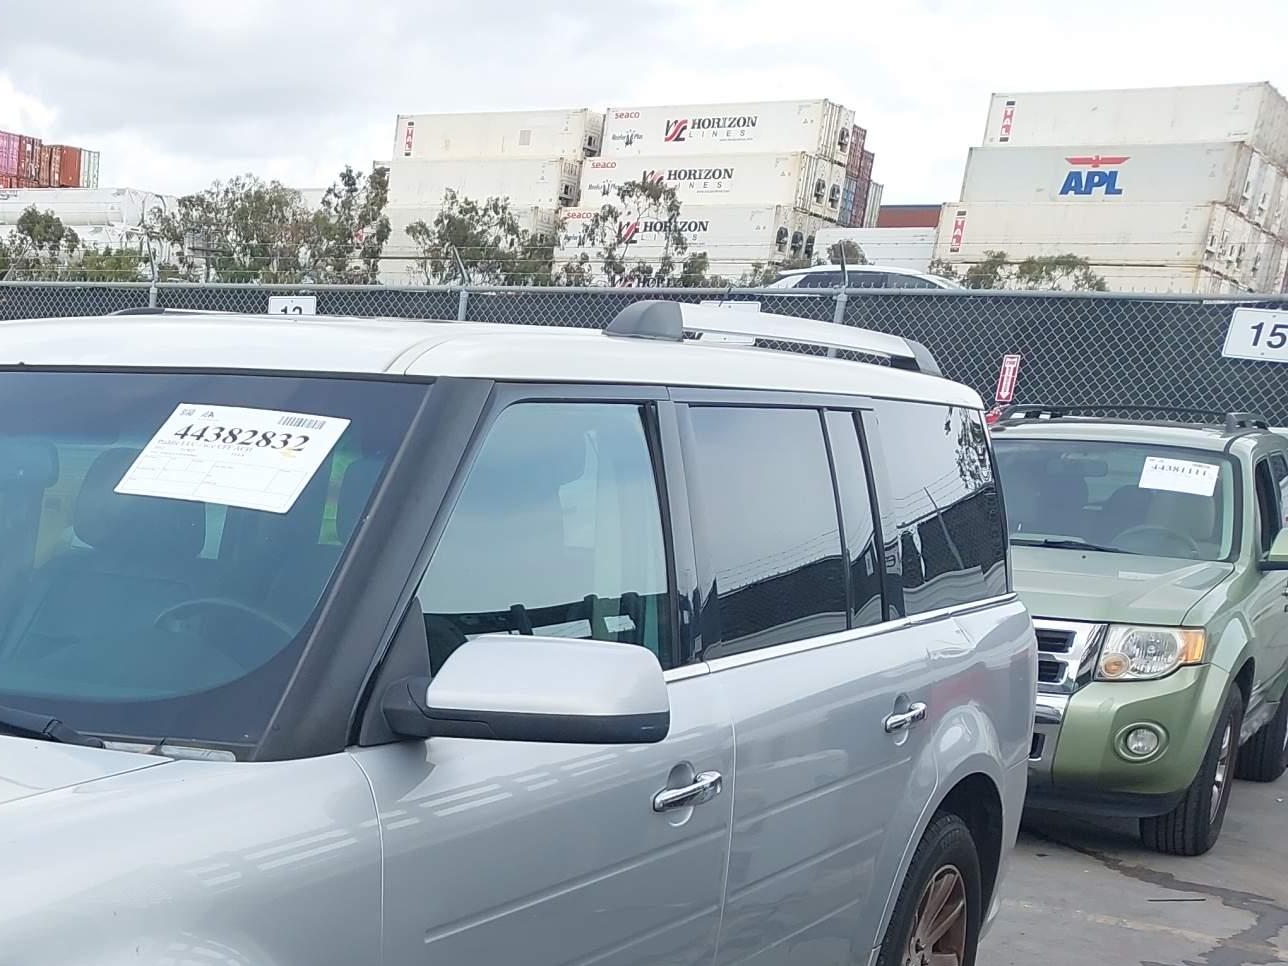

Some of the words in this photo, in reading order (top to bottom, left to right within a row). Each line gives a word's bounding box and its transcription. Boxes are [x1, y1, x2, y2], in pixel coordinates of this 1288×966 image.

[690, 116, 758, 130] HORIZON
[688, 129, 746, 139] LINES
[666, 168, 734, 181] HORIZON
[1059, 170, 1123, 196] APL
[1250, 322, 1288, 349] 15
[174, 423, 310, 452] 44382832
